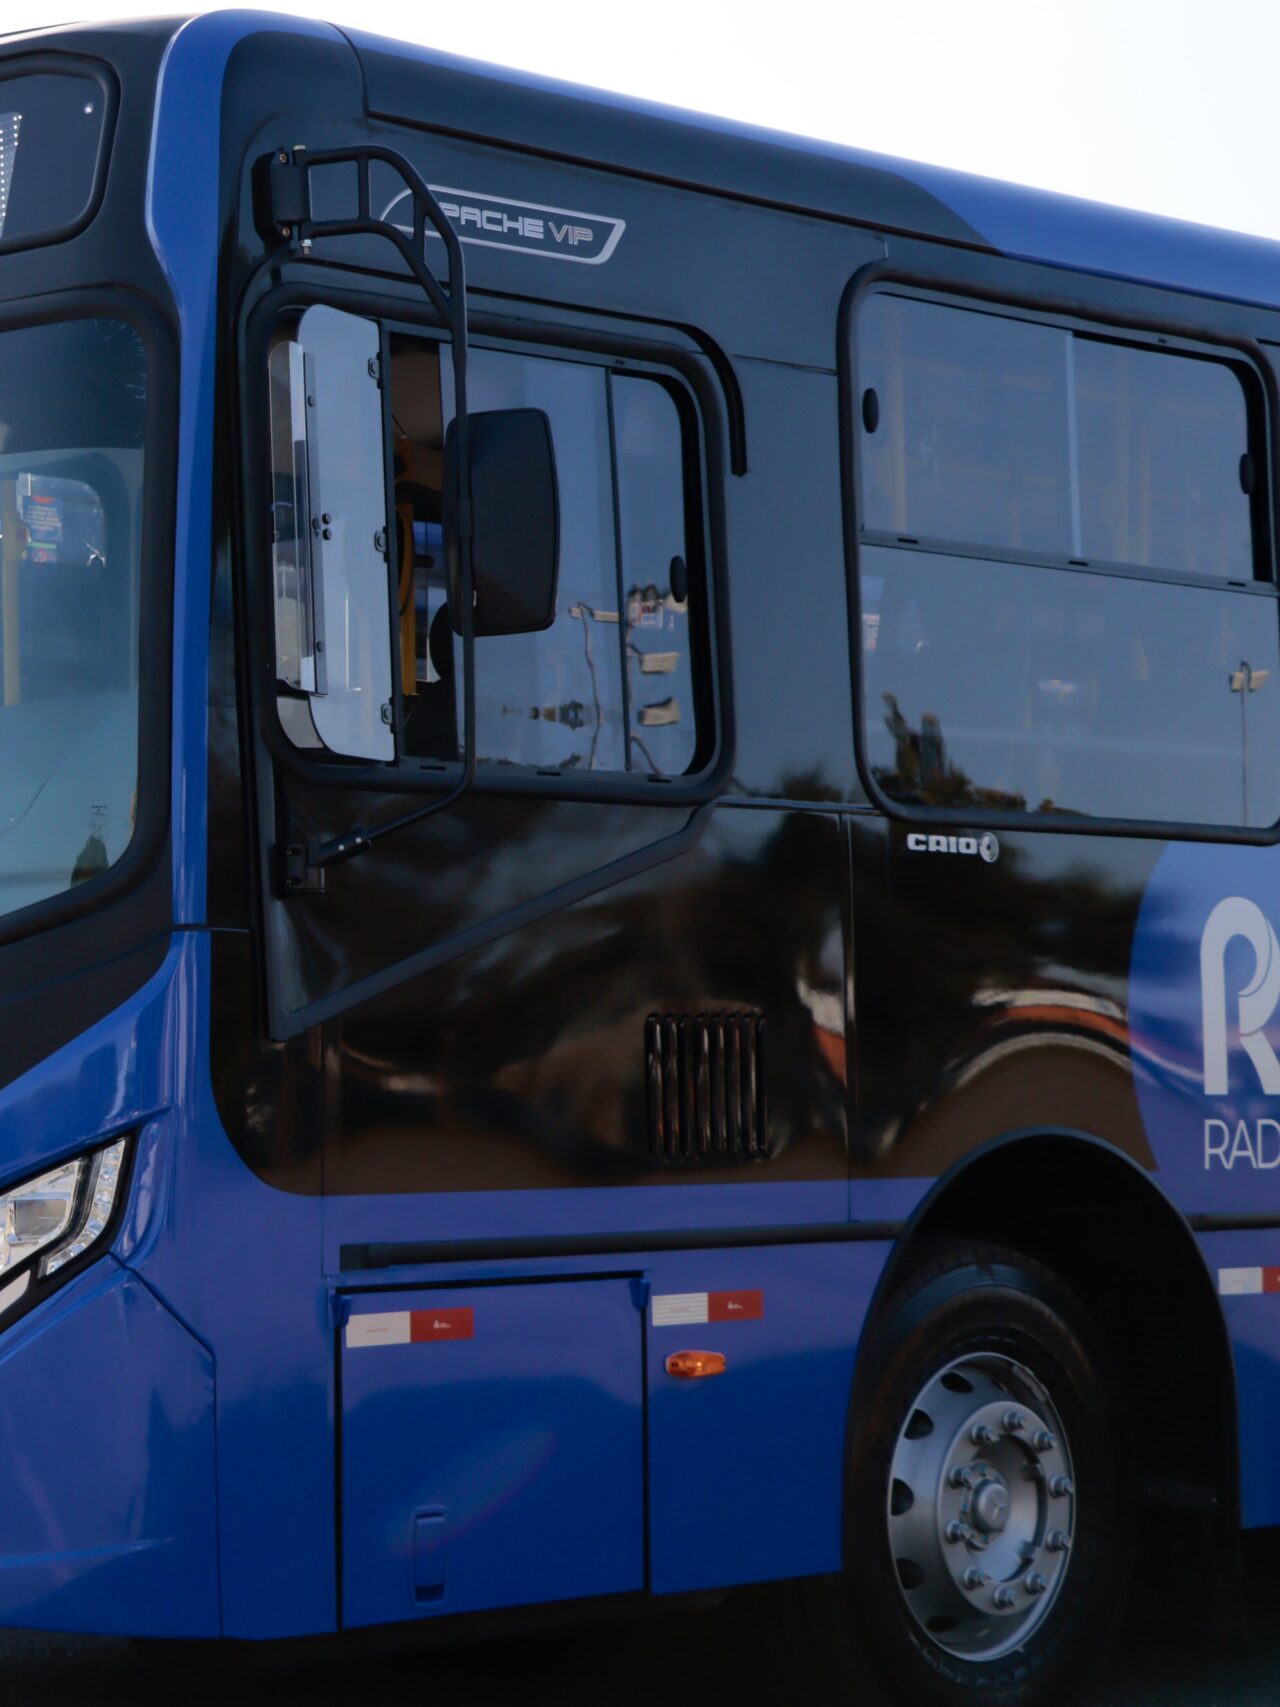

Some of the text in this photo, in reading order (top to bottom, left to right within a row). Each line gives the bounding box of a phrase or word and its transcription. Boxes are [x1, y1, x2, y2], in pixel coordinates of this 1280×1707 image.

[439, 201, 593, 246] PACHE VIP
[907, 833, 978, 855] CAIO
